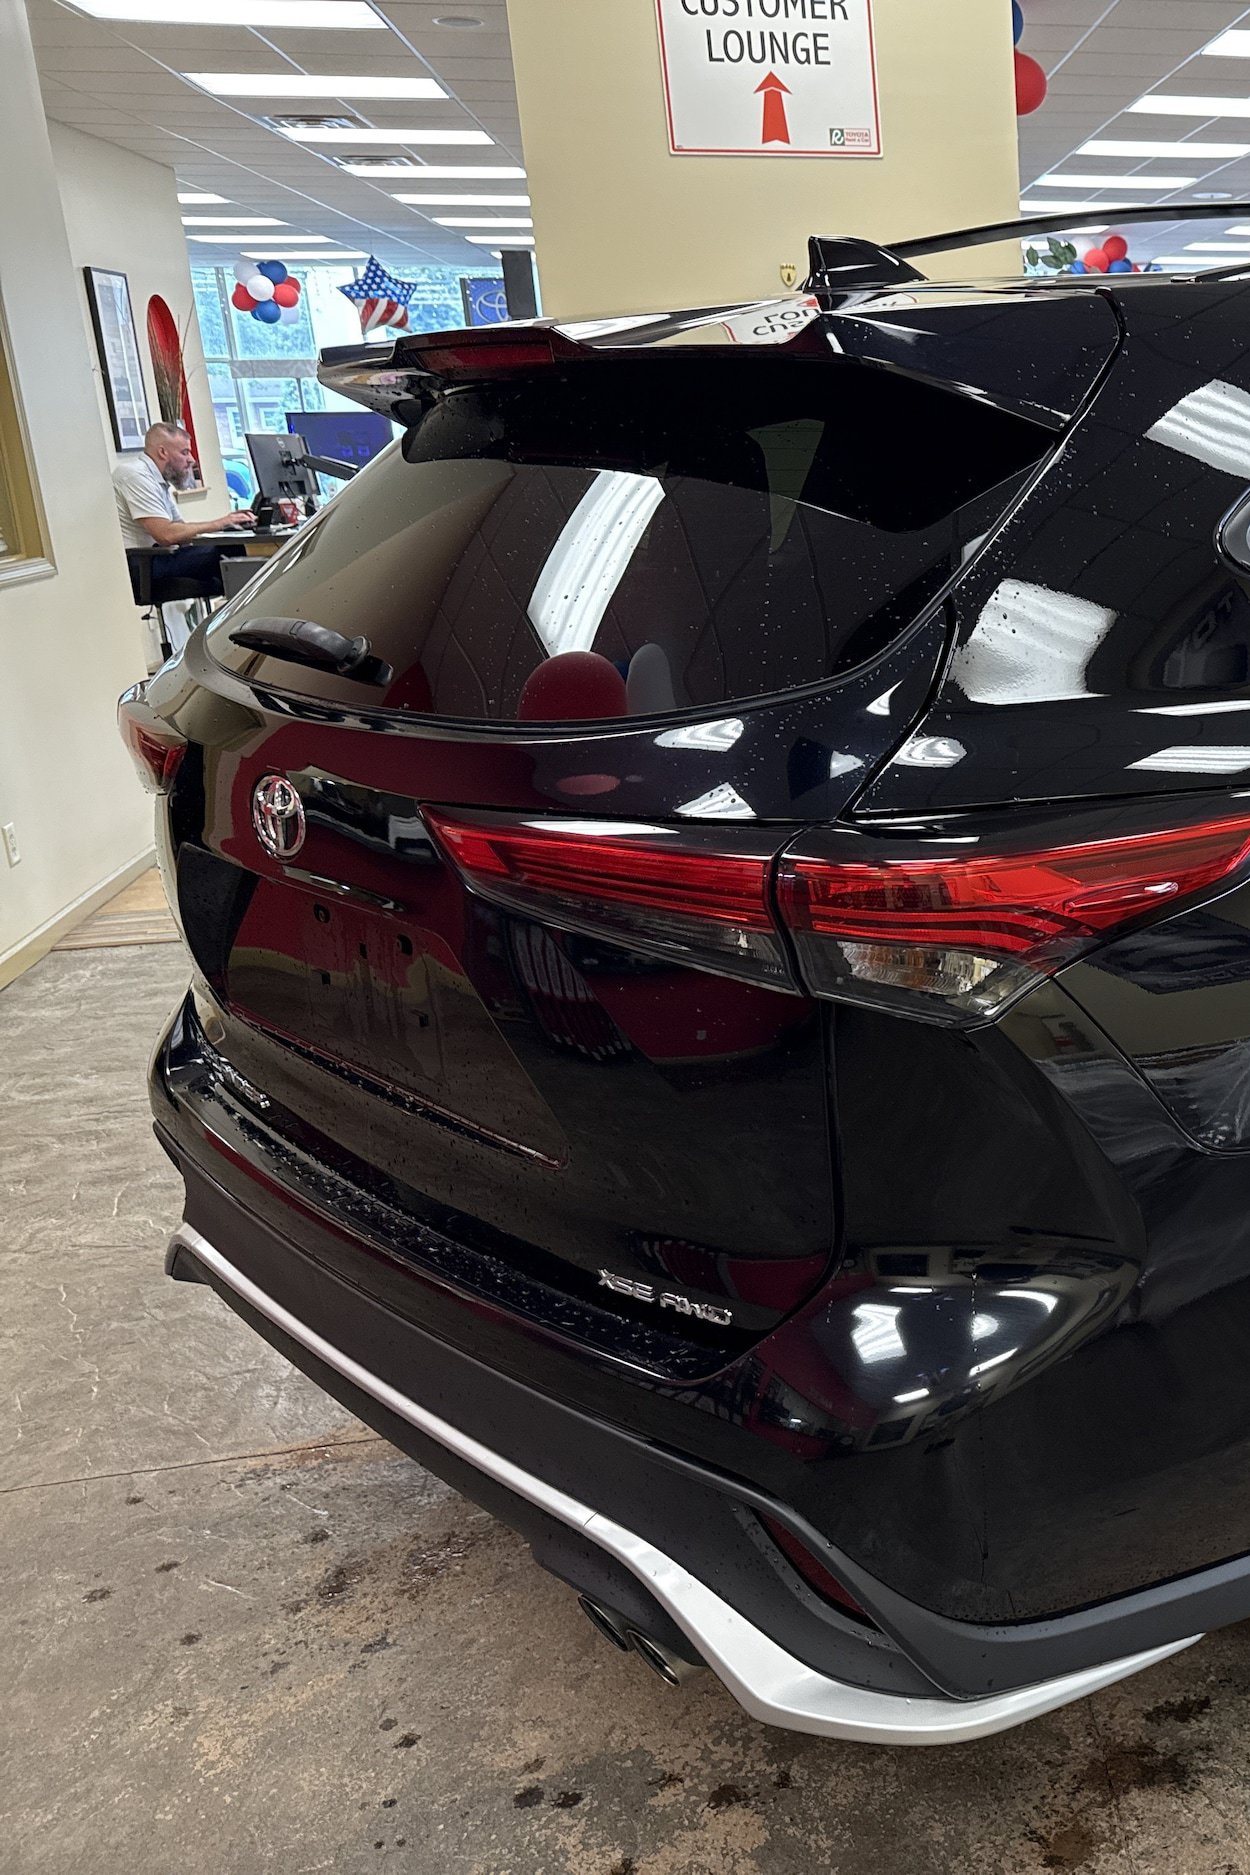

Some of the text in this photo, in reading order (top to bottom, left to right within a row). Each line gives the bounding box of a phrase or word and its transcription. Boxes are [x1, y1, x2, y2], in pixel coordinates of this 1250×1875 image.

[706, 29, 831, 65] LOUNGE
[597, 1268, 732, 1326] XSE AWD
